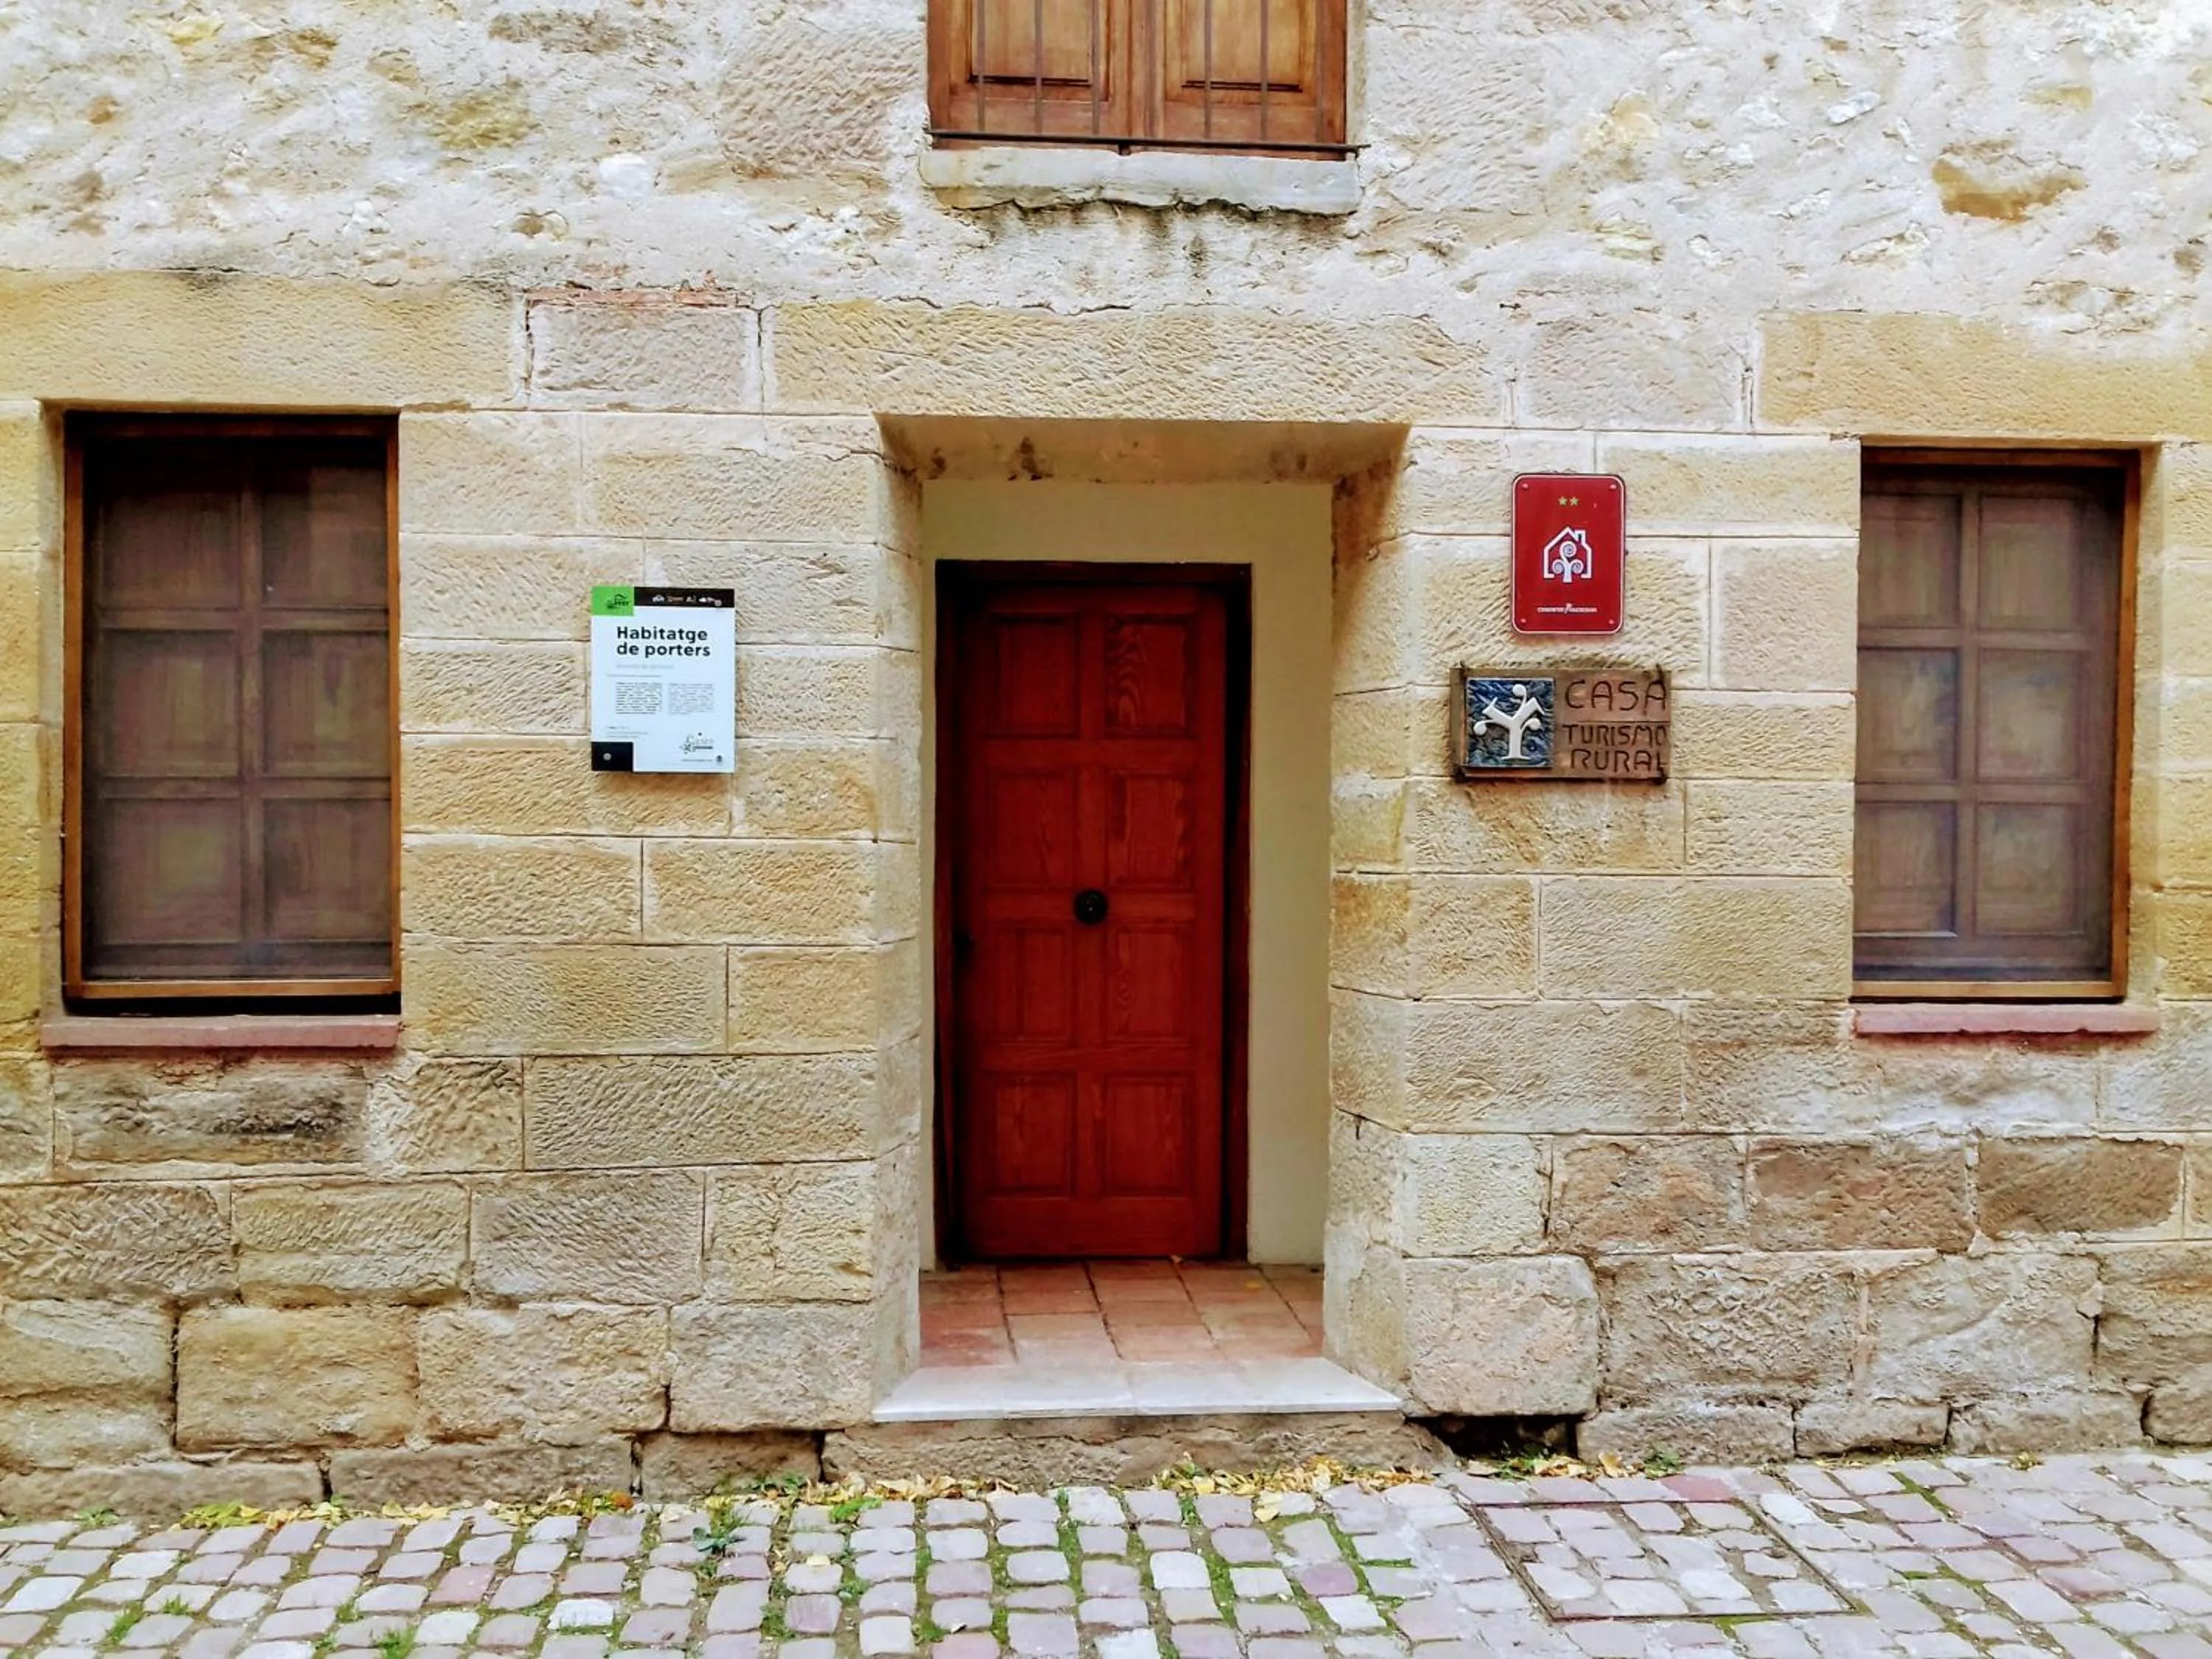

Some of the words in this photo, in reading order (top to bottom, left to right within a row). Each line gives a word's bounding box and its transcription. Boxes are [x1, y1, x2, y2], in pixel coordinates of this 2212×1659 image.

[617, 626, 708, 644] Habitatge
[616, 641, 639, 655] de
[645, 644, 710, 658] porters
[1565, 679, 1666, 713] CASA
[1562, 724, 1666, 748] TURISMO
[1571, 749, 1666, 773] RURAL
